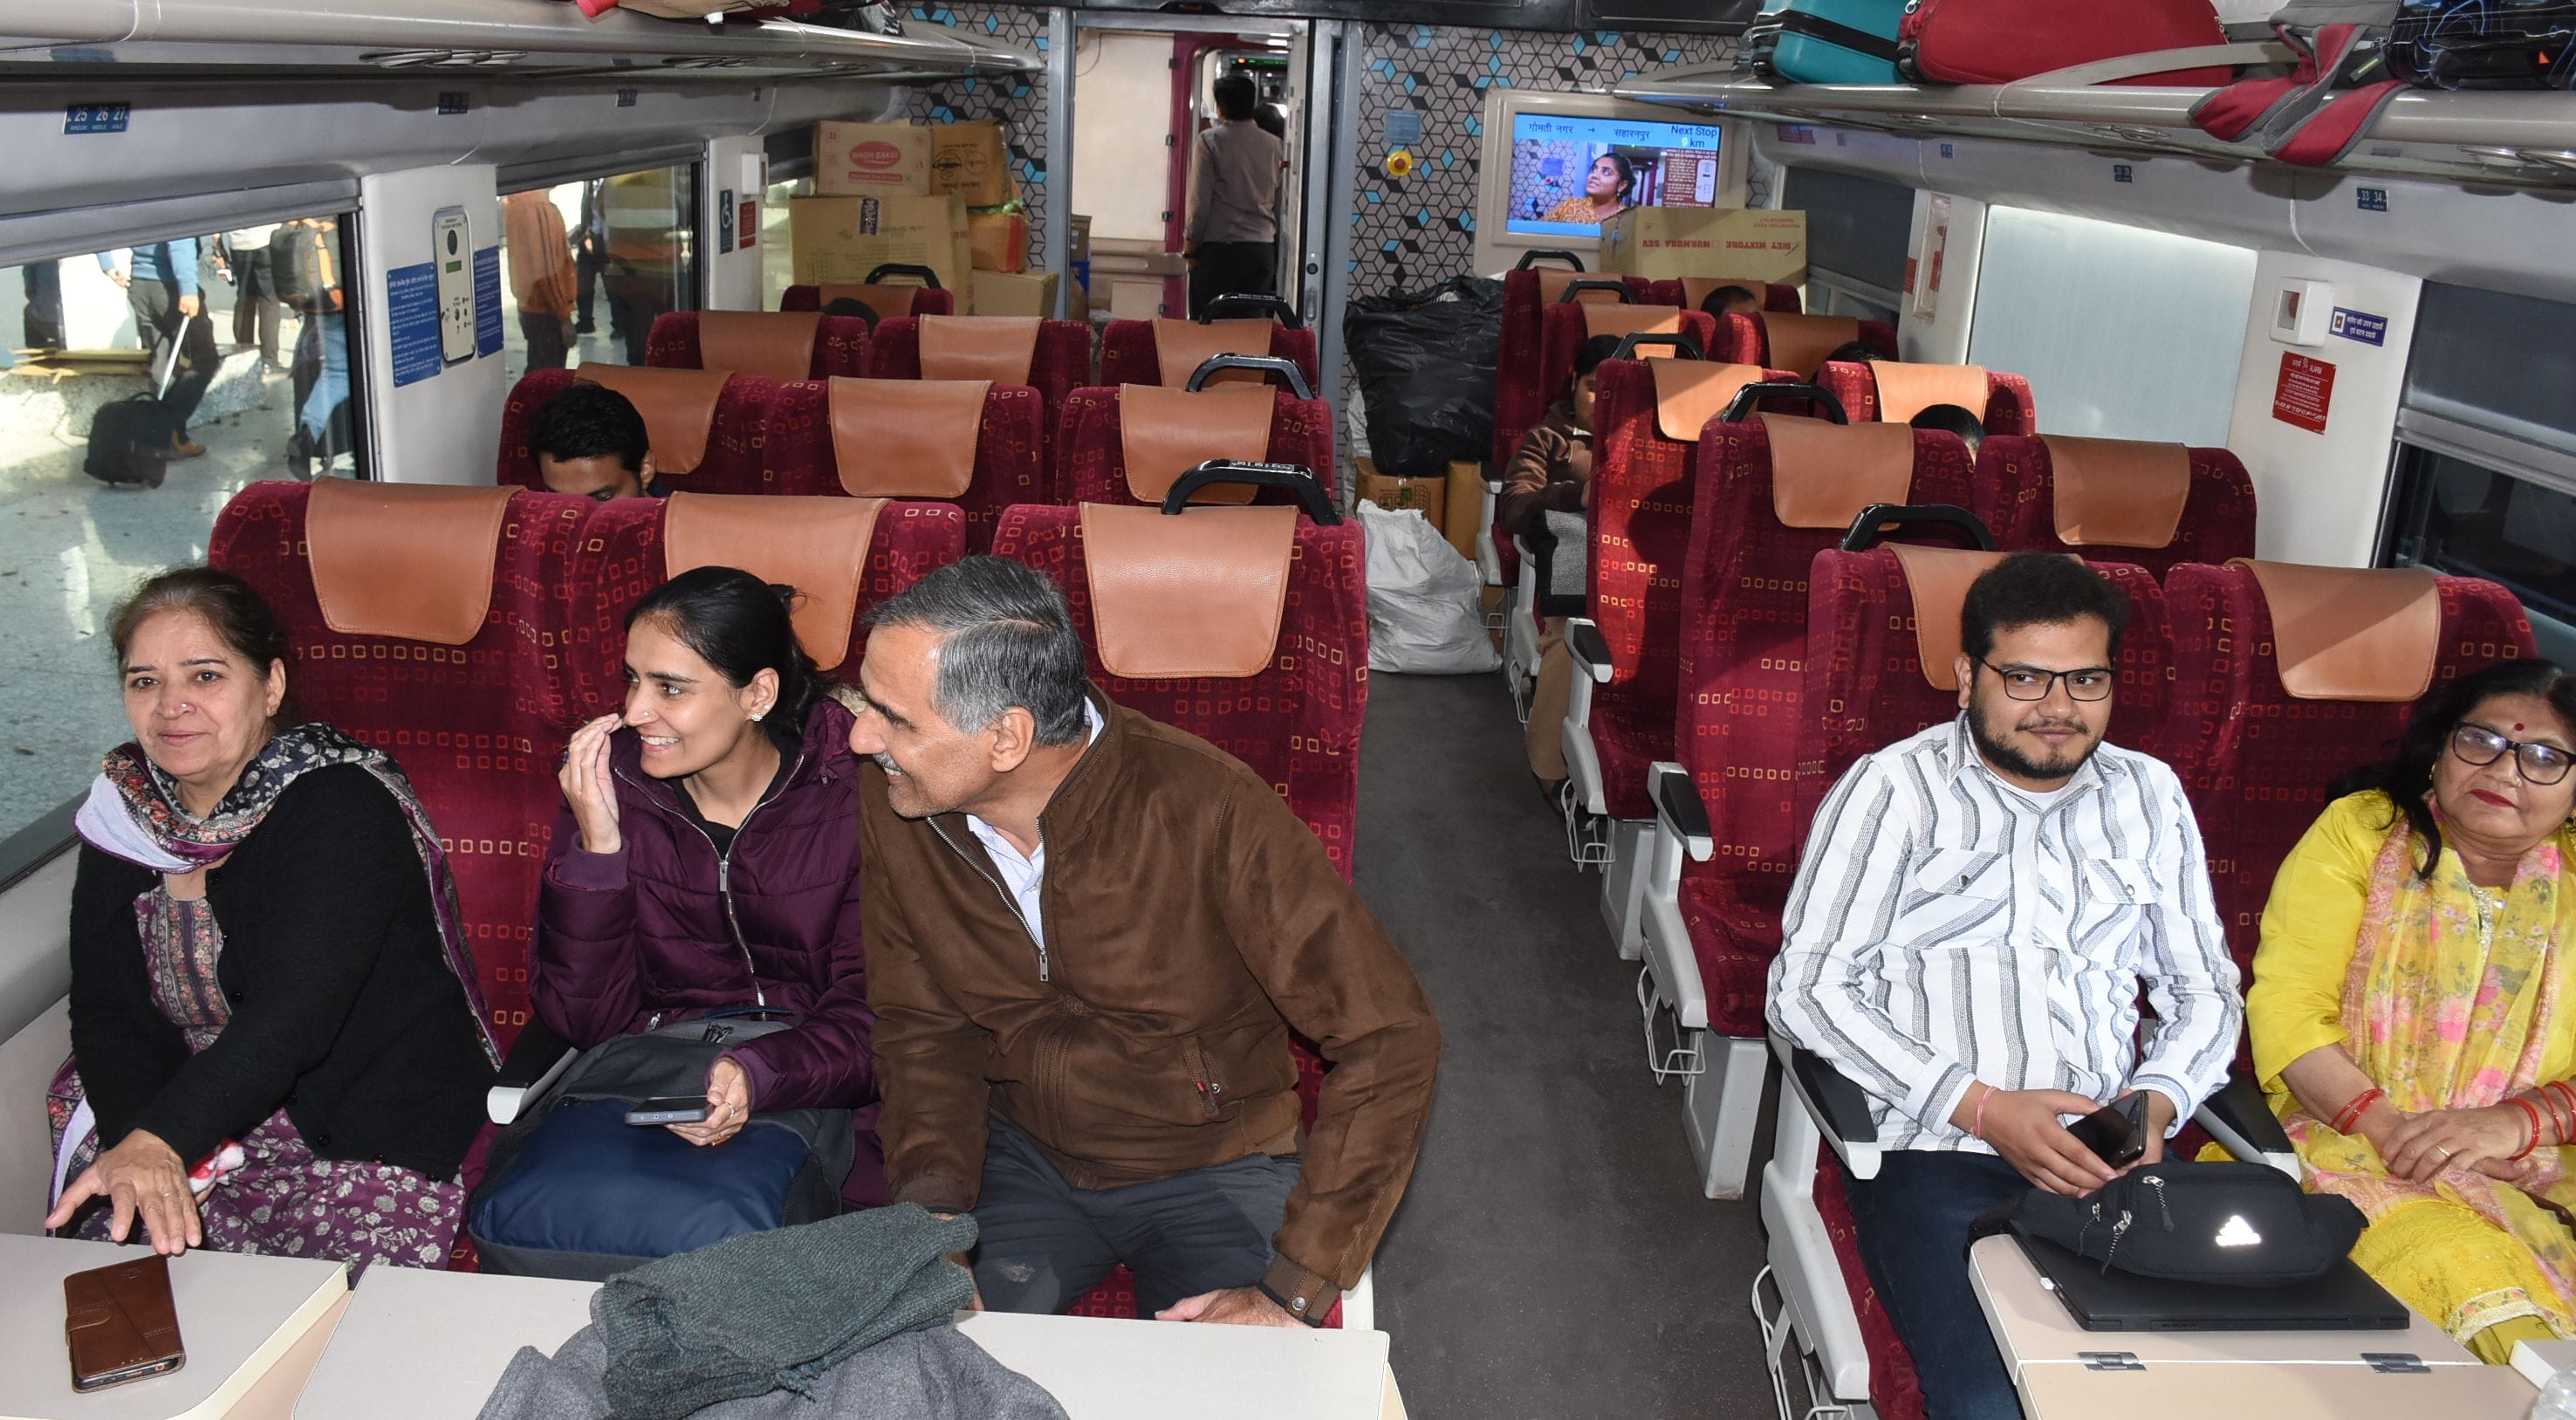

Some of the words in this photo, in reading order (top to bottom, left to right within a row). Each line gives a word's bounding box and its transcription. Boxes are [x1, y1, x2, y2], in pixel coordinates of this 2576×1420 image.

[74, 107, 87, 122] 25
[95, 106, 109, 121] 26
[113, 106, 127, 121] 27
[1529, 121, 1552, 133] गोमती
[1556, 125, 1573, 134] नगर
[1613, 128, 1651, 141] सहारनपुर
[1671, 125, 1693, 135] Next
[1696, 127, 1717, 139] Stop
[1689, 138, 1705, 148] km
[2361, 190, 2370, 201] 33
[2374, 191, 2383, 202] 34
[1642, 239, 1660, 248] SEV
[1665, 239, 1710, 249] MURMURA
[1725, 240, 1766, 250] MIXTURE
[1771, 241, 1792, 250] DIET
